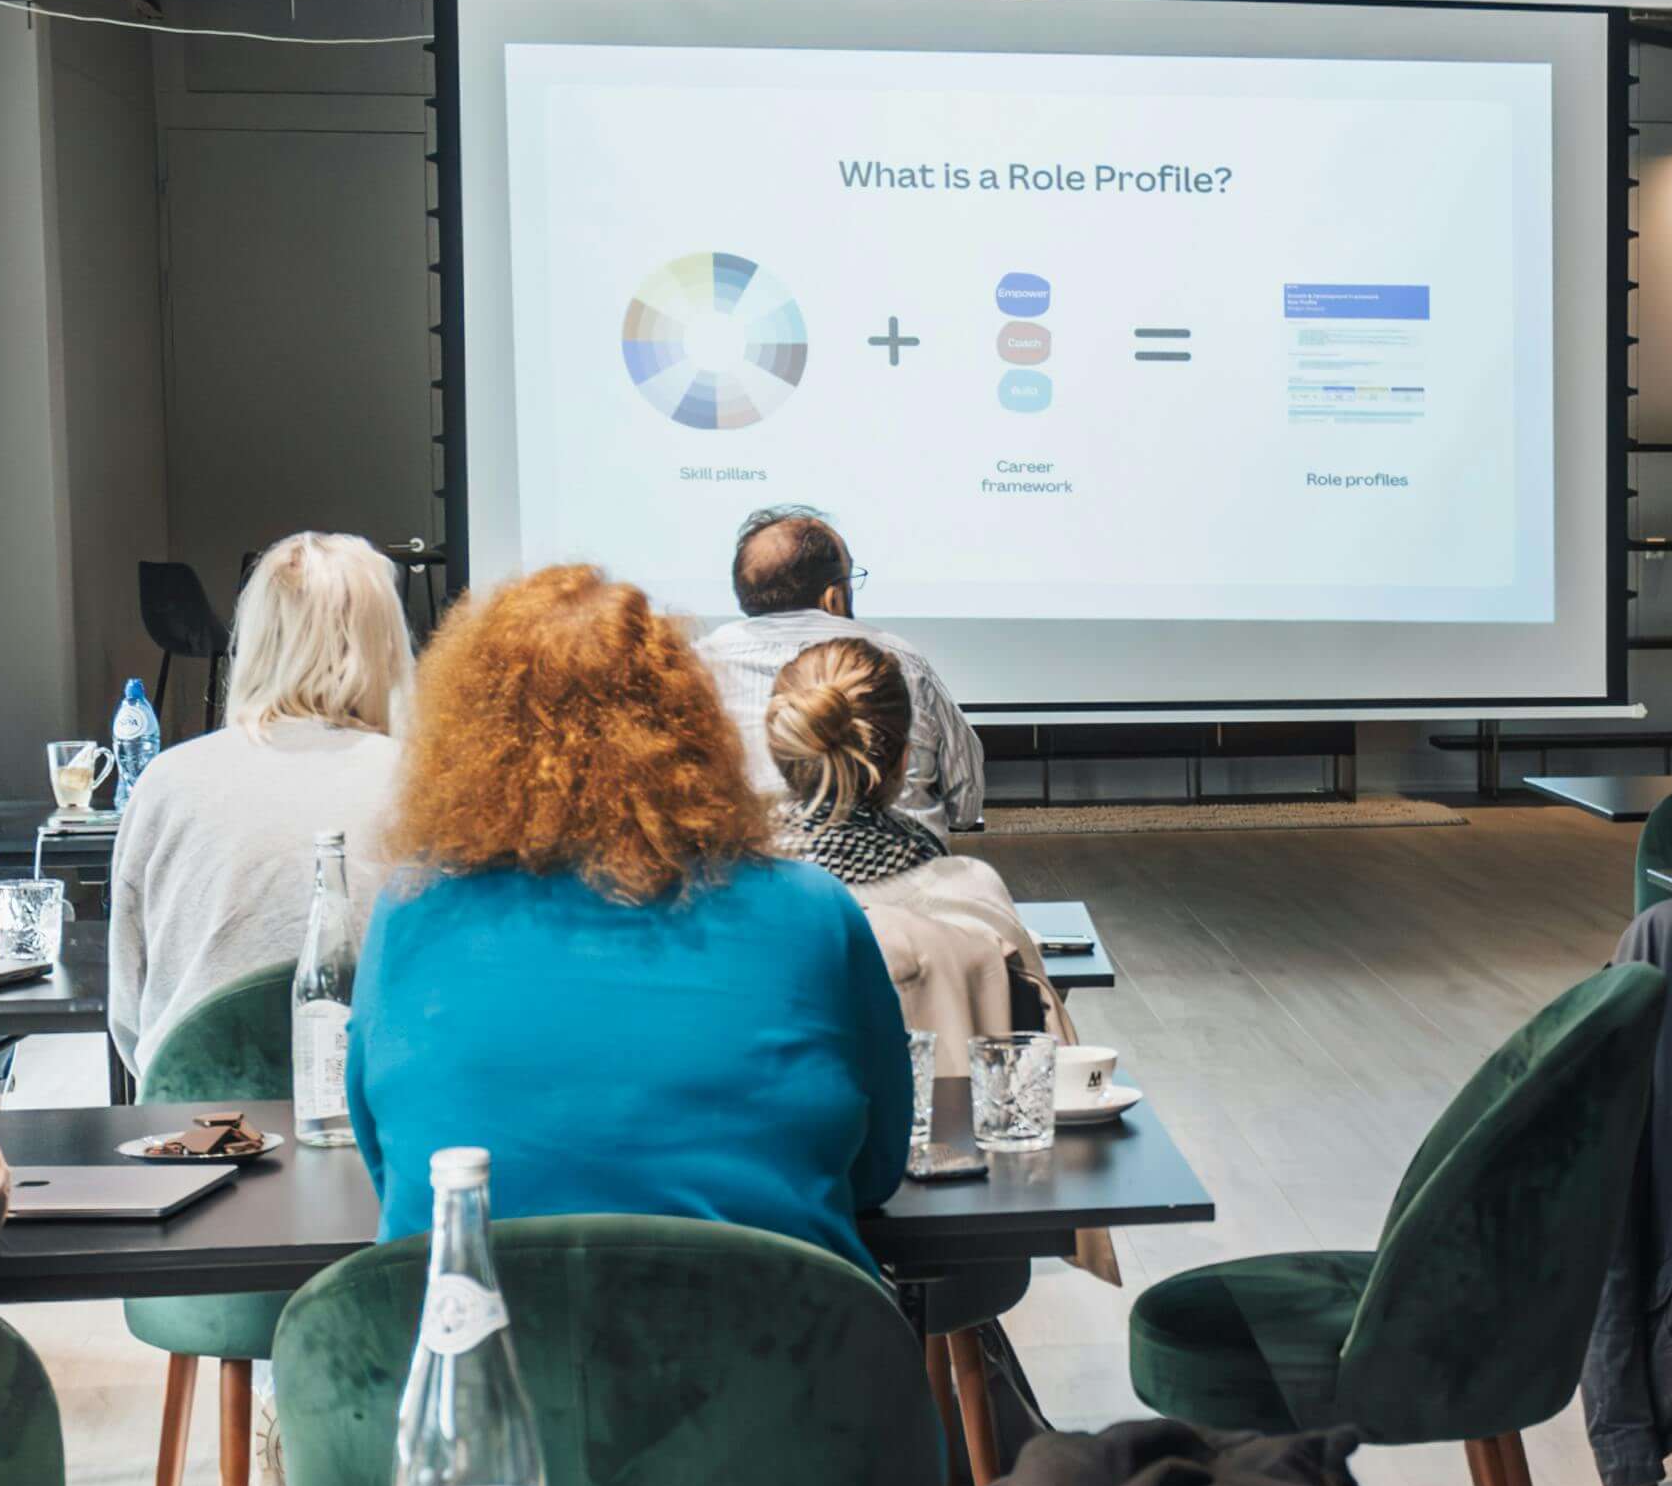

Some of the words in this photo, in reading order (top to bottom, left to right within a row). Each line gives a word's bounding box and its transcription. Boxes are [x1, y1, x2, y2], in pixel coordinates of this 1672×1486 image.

[839, 161, 936, 190] What
[944, 163, 971, 190] is
[979, 169, 1000, 190] a
[1009, 164, 1085, 191] Role
[1095, 165, 1232, 193] Profile?
[998, 288, 1048, 299] Empower
[996, 460, 1054, 474] Career
[679, 467, 712, 480] Skill
[716, 467, 768, 483] pillars
[1306, 473, 1342, 486] Role
[1345, 472, 1408, 489] profiles
[981, 478, 1073, 493] framework
